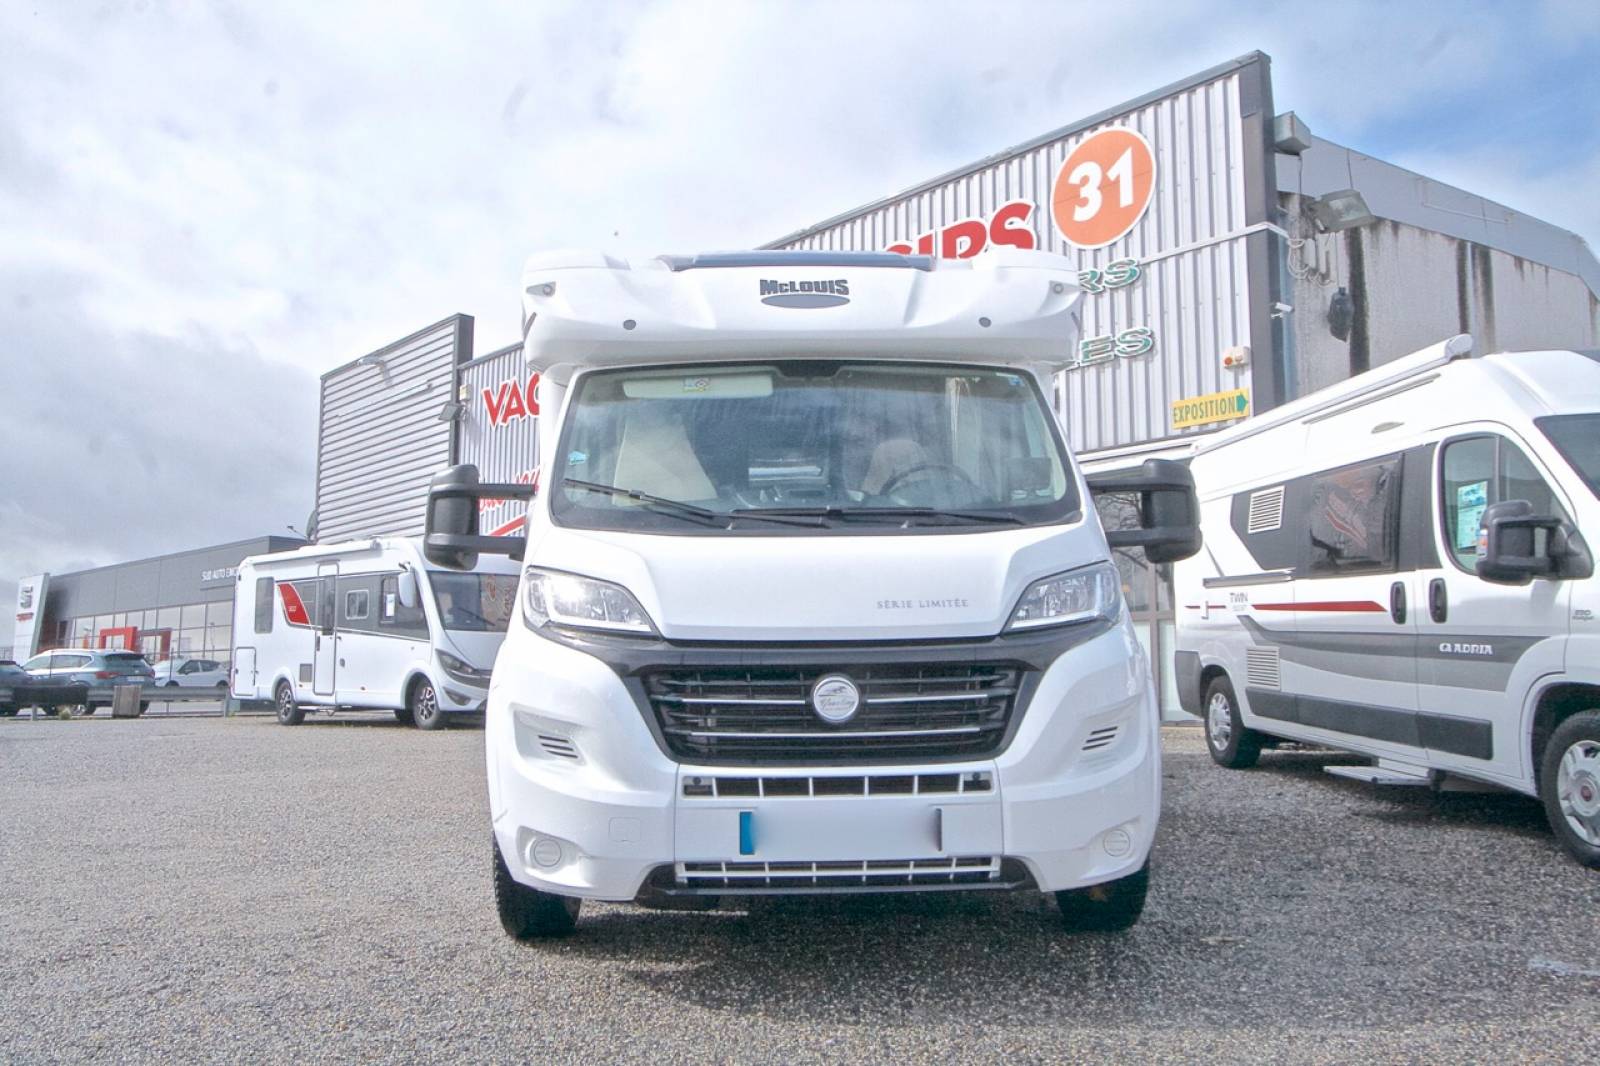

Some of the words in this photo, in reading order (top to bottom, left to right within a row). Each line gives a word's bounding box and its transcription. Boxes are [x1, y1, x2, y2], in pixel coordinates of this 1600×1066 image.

[1067, 147, 1133, 222] 31
[1078, 328, 1153, 366] ES
[1173, 396, 1235, 423] EXPOSITION
